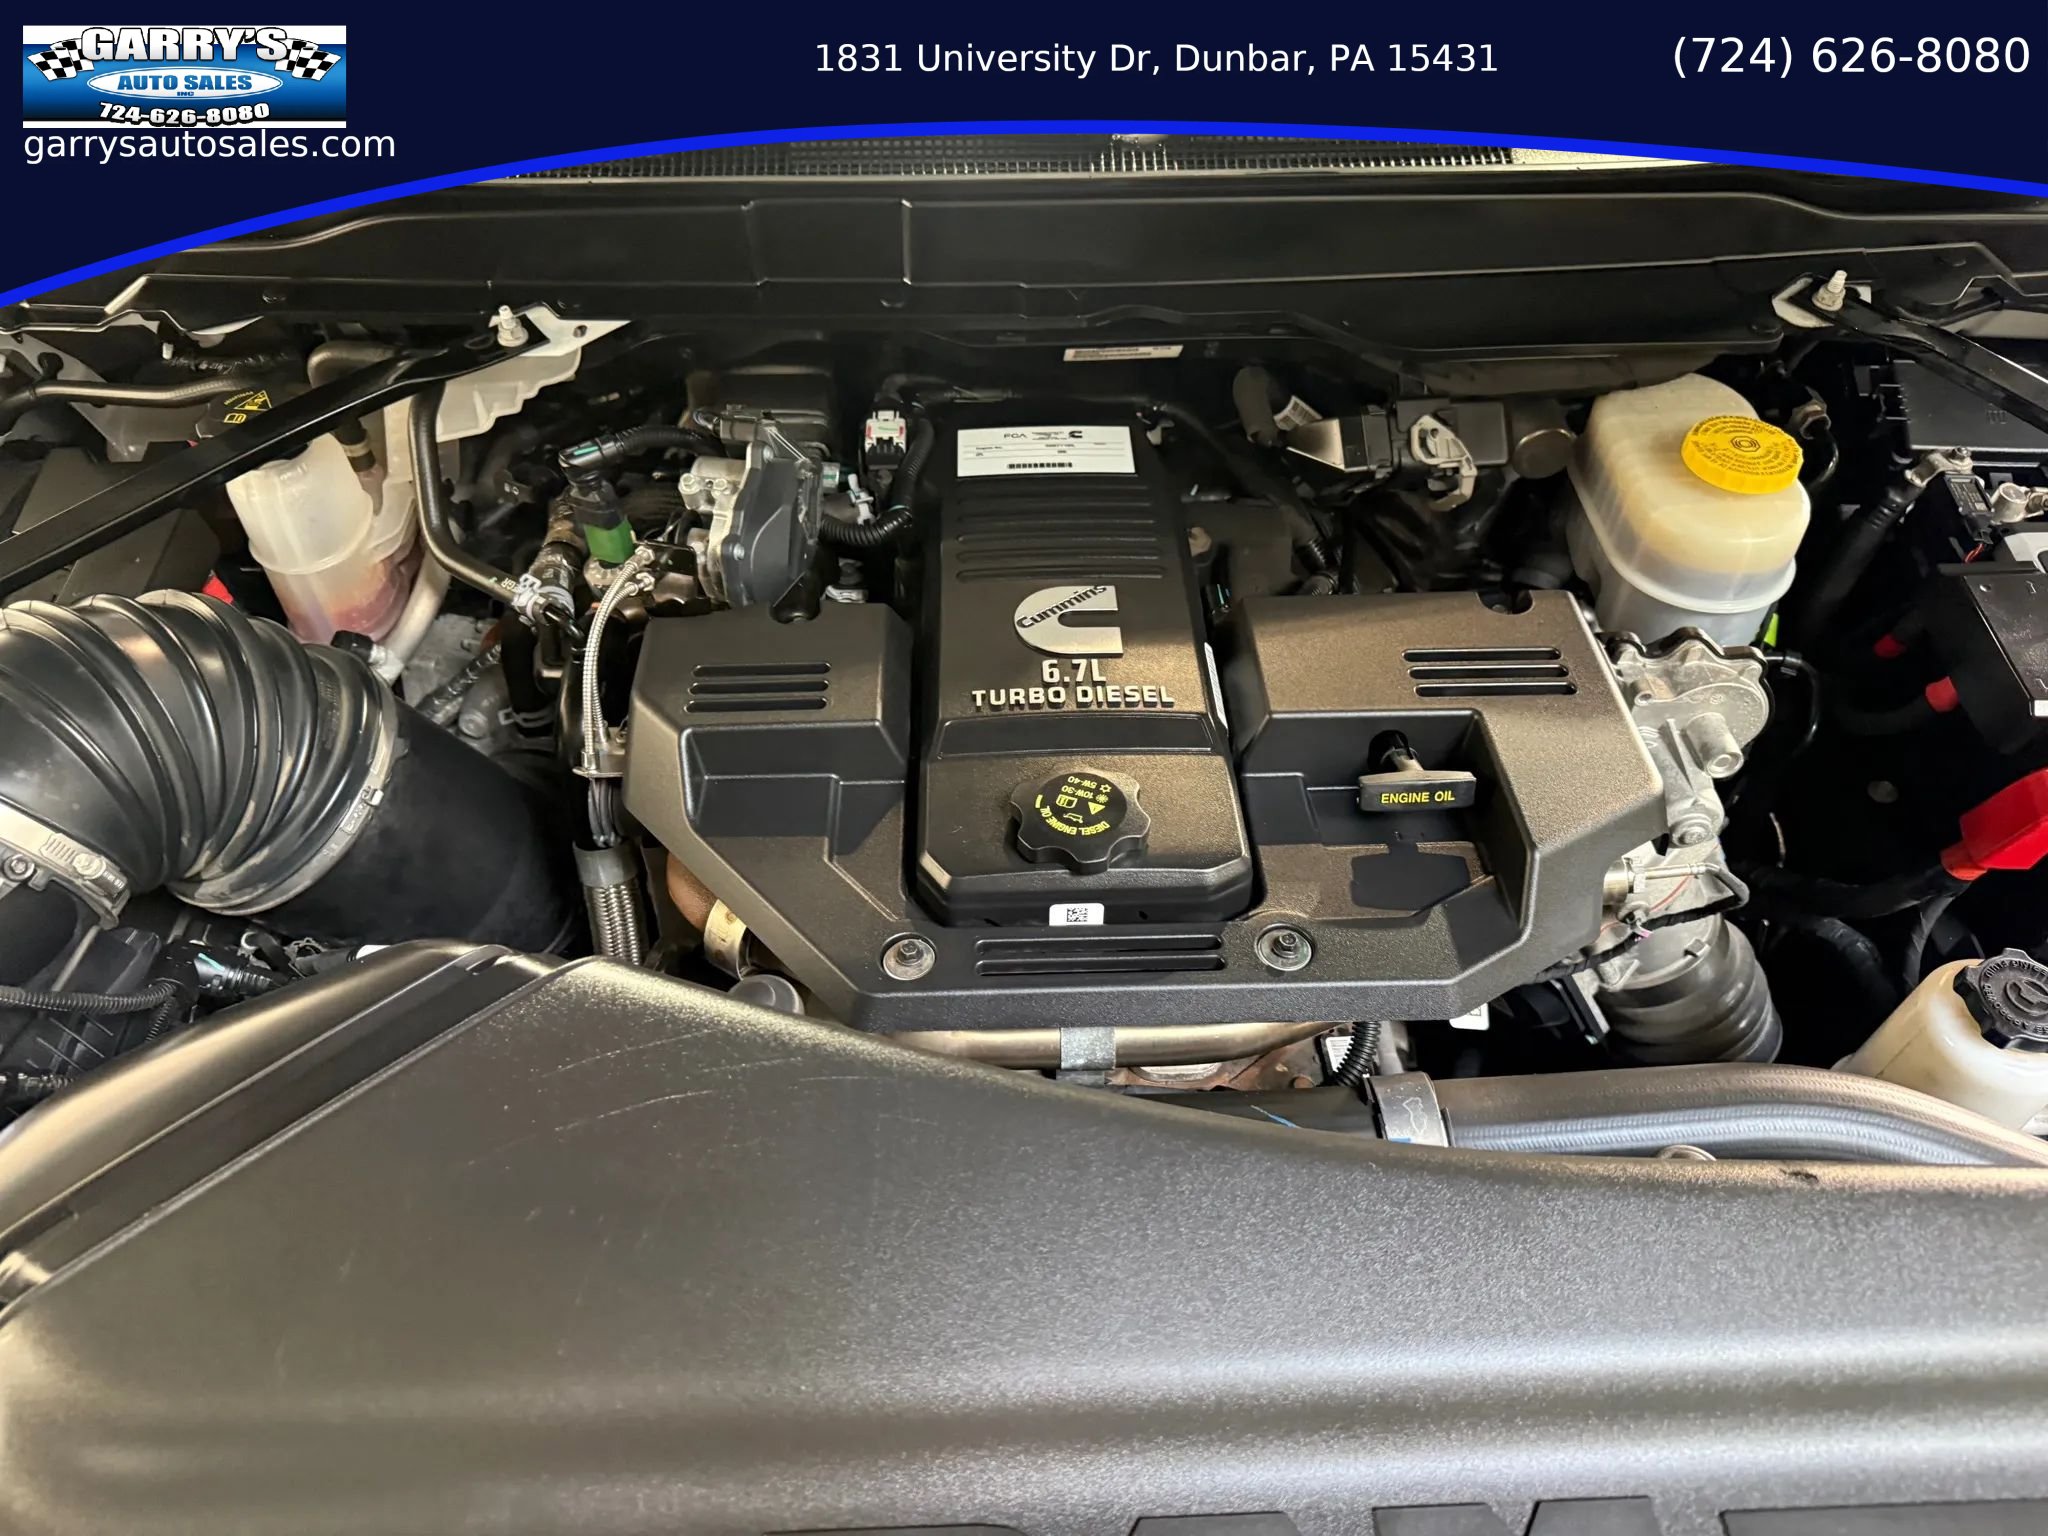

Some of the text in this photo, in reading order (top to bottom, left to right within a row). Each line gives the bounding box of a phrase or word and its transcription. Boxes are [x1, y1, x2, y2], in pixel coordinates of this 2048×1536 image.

[1016, 584, 1108, 629] Cummins
[1041, 658, 1107, 684] 6.7L
[971, 684, 1176, 708] TURBO DIESEL
[1067, 775, 1098, 789] 5W-40
[1061, 785, 1095, 800] 10W-30
[1380, 790, 1456, 804] ENGINE OIL
[1045, 816, 1077, 836] ENGINE
[1079, 820, 1110, 836] DIESEL
